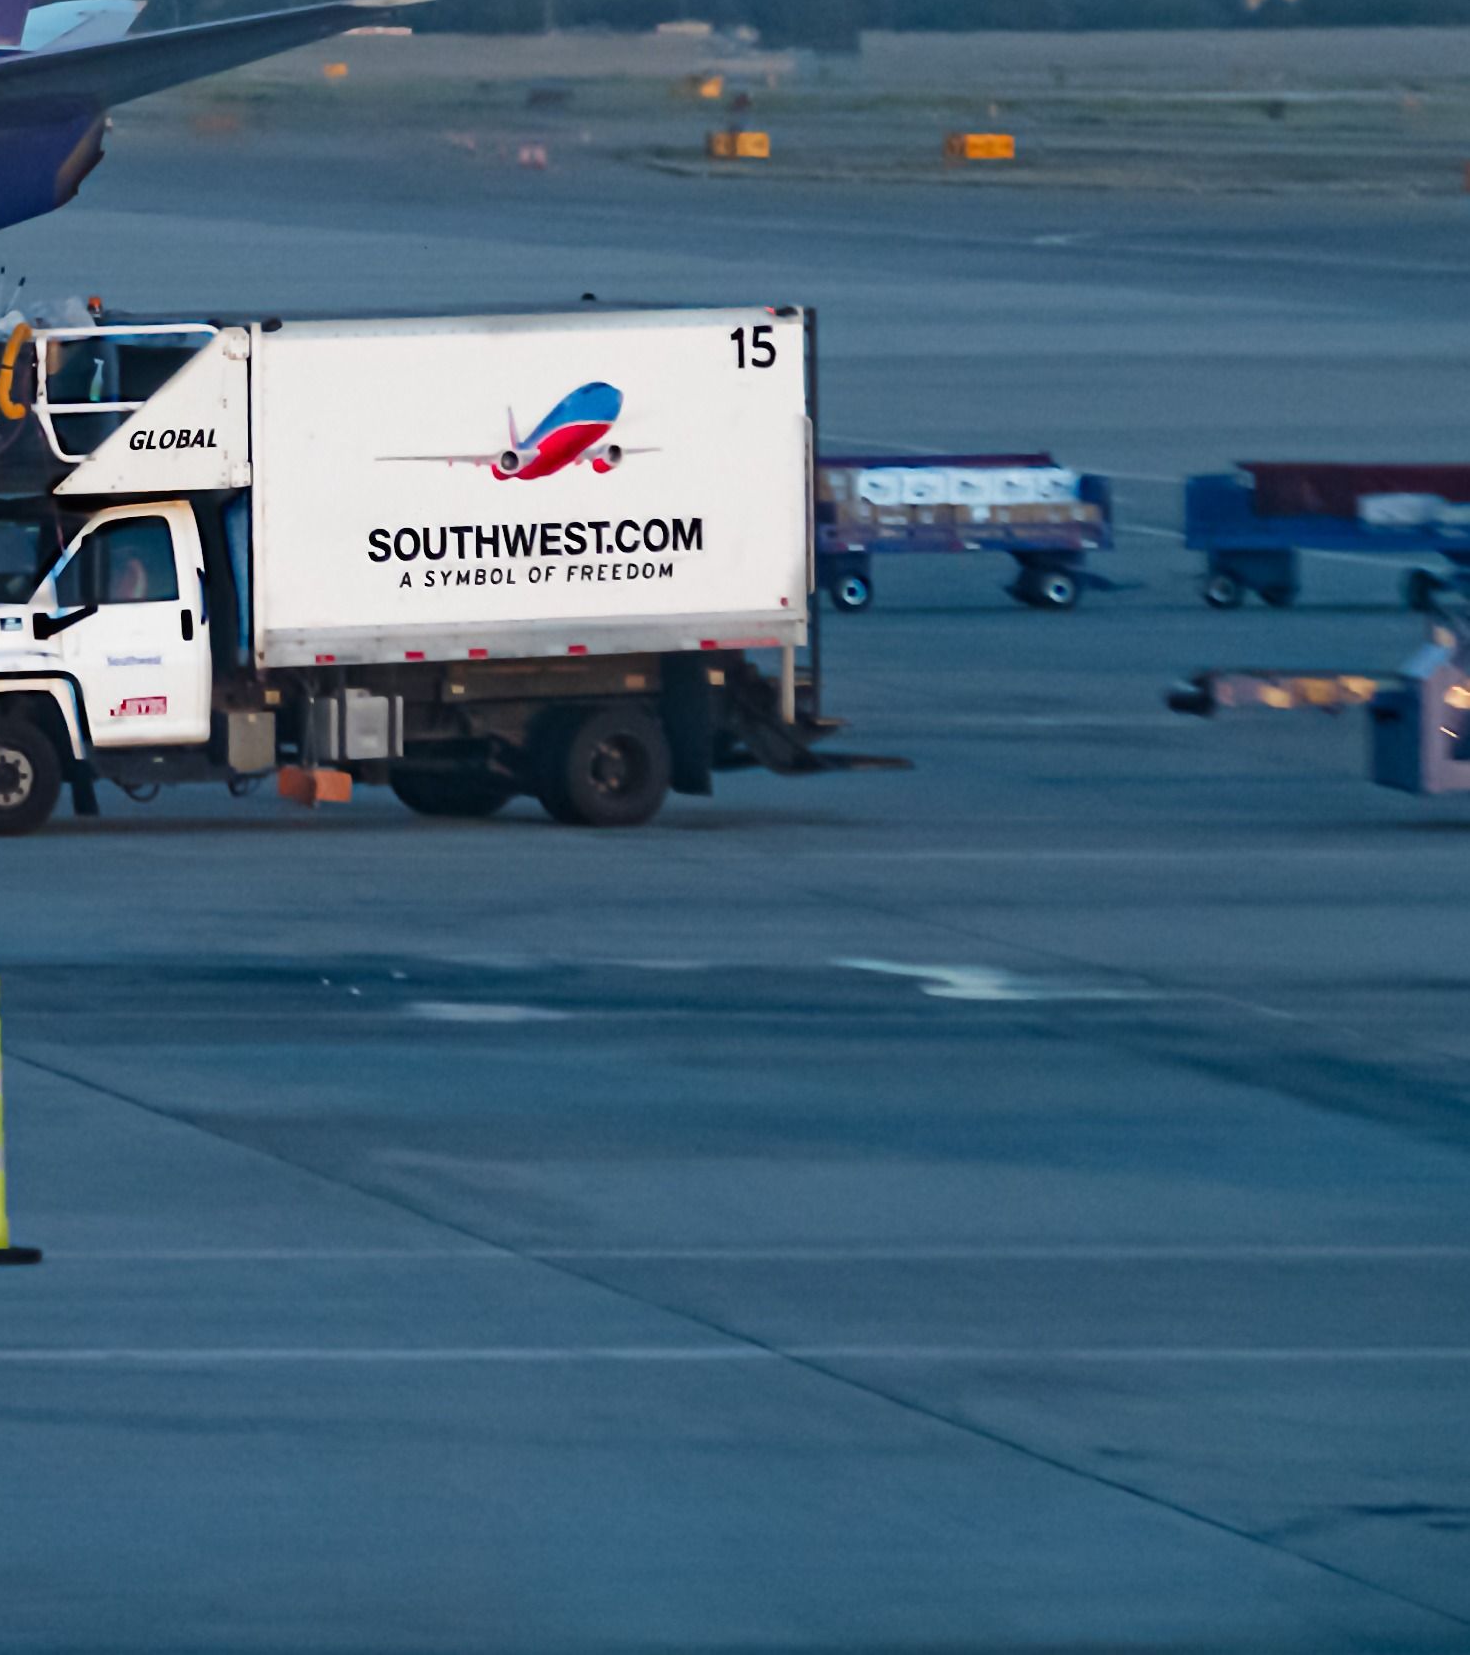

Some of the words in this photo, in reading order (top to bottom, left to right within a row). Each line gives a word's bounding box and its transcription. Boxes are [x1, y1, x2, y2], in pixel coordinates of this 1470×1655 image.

[730, 325, 777, 369] 15
[129, 428, 217, 451] GLOBAL
[368, 518, 703, 563] SOUTHWEST.COM
[399, 571, 413, 588] A
[424, 565, 516, 588] SYMBOL
[528, 565, 557, 584] OF
[566, 562, 674, 583] FREEDOM
